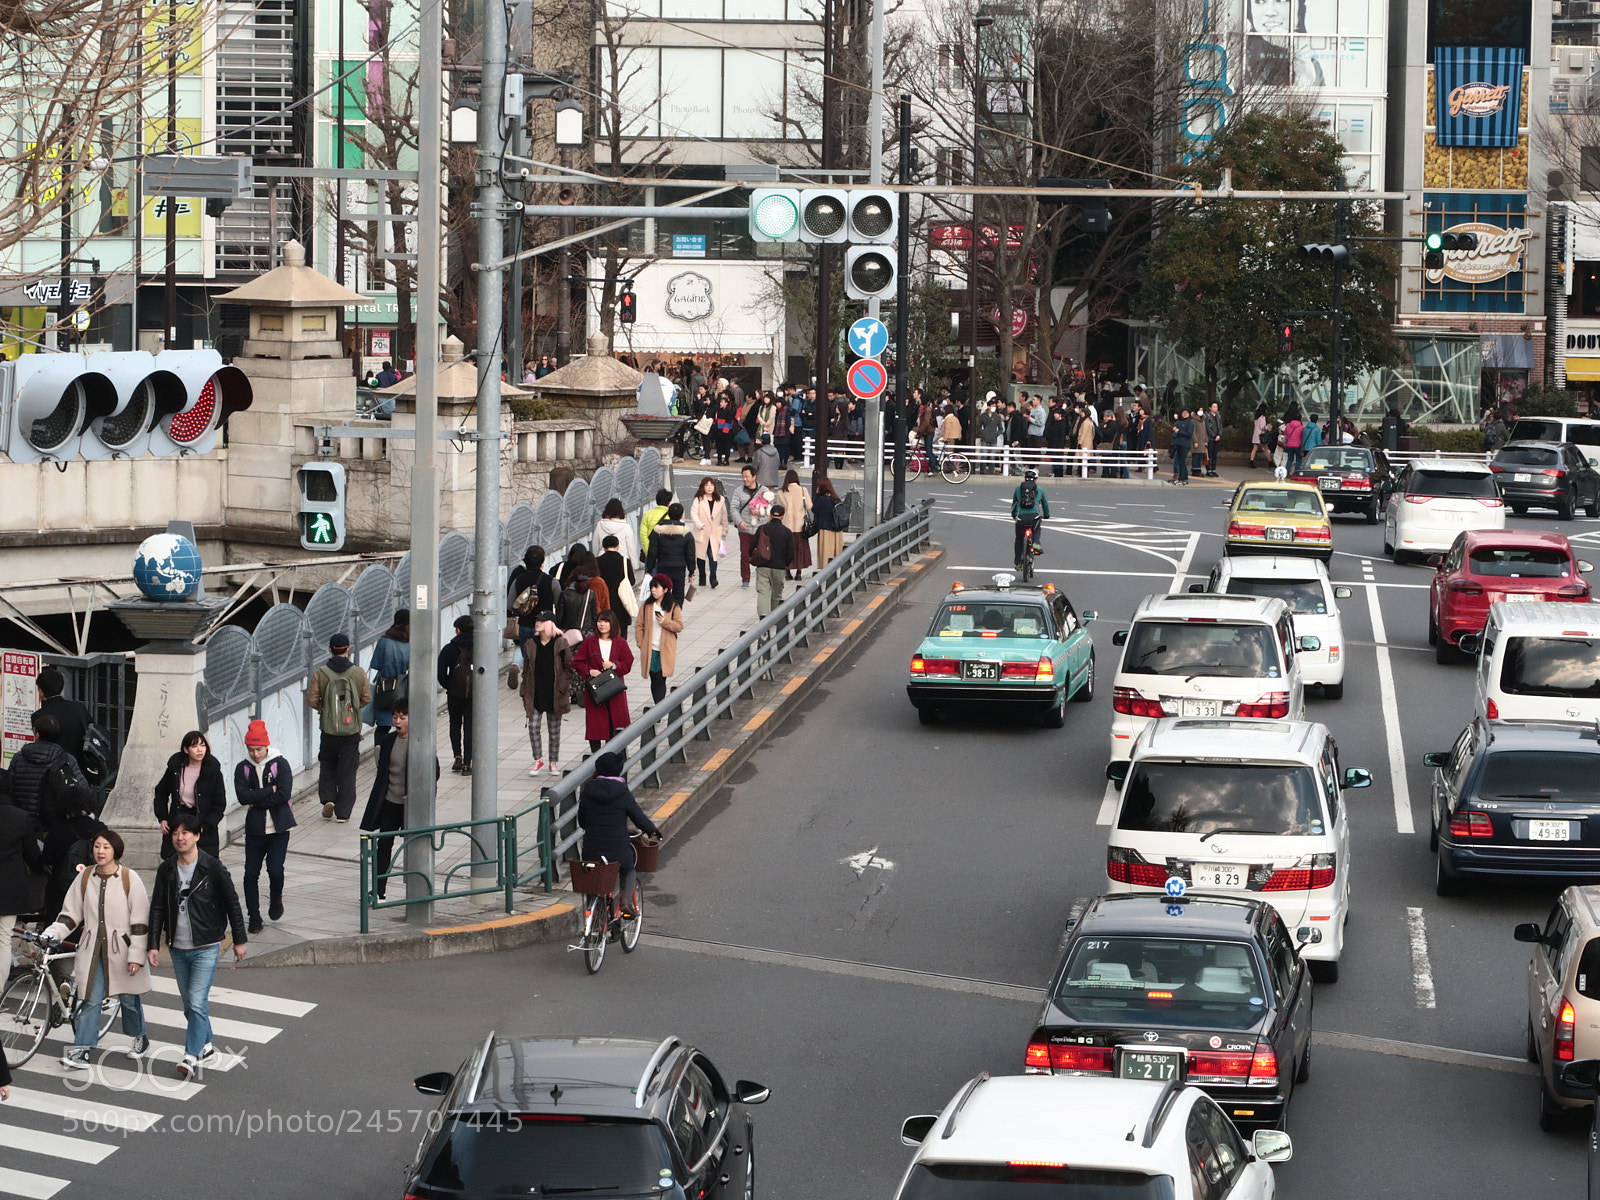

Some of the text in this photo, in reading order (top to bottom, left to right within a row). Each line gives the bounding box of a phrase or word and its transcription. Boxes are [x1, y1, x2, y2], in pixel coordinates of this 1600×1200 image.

[1448, 86, 1511, 117] Garrett
[373, 341, 388, 349] 70%
[1566, 334, 1600, 349] DOU
[972, 669, 995, 678] 98-13
[1538, 828, 1567, 839] 49-89
[1087, 941, 1110, 950] 217
